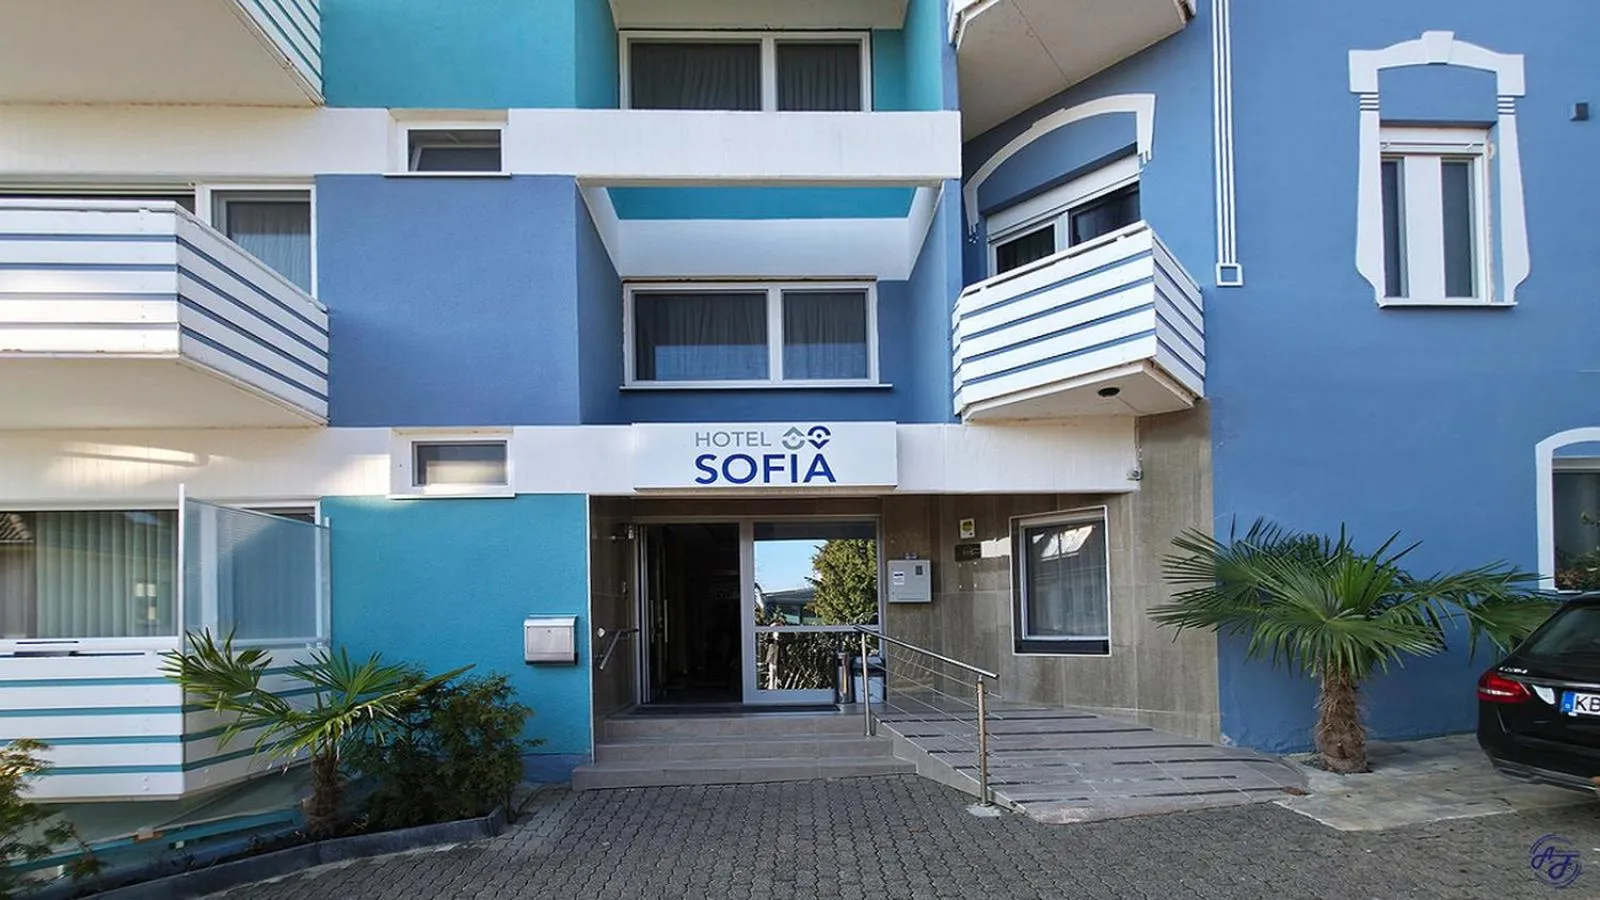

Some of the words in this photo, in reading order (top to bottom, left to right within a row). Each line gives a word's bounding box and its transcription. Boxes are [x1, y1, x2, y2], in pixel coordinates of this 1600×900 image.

[695, 431, 772, 447] HOTEL
[695, 453, 837, 484] SOFIA
[1575, 695, 1600, 712] KB
